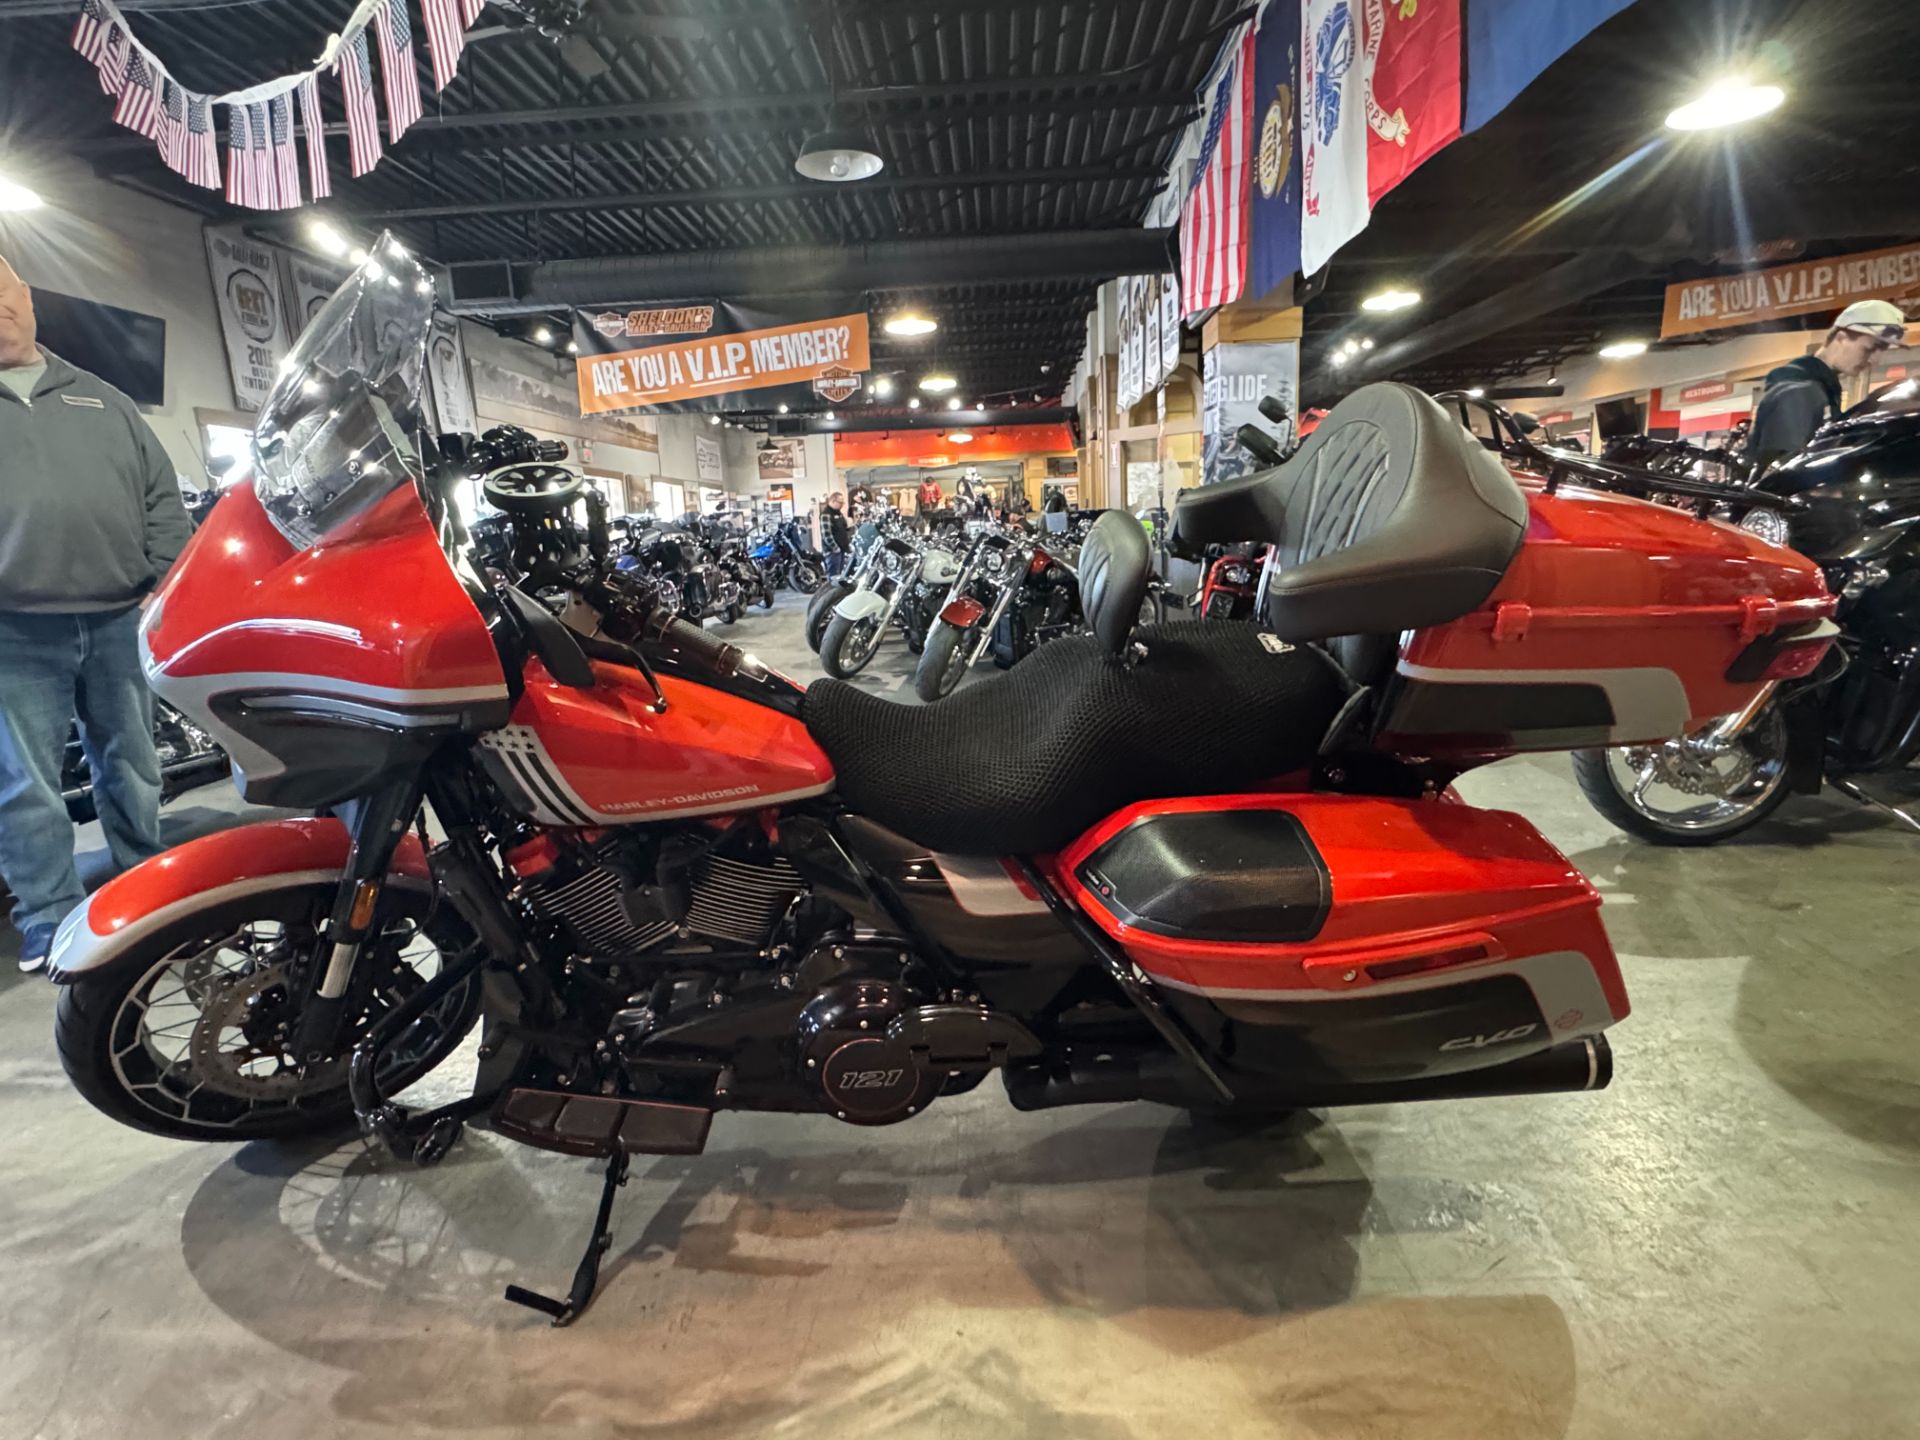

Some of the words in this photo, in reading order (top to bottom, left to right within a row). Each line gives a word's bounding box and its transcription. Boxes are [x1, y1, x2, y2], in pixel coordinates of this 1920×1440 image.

[1679, 284, 1716, 320] ARE
[1718, 278, 1751, 312] YOU
[1756, 275, 1770, 308] A
[1773, 266, 1834, 304] V.I.P.
[628, 307, 712, 326] SHELDON'S
[591, 360, 629, 397] ARE
[628, 353, 666, 390] YOU
[670, 351, 684, 385] A
[684, 343, 750, 382] V.I.P.
[750, 326, 850, 373] MEMBER?
[1219, 374, 1268, 401] GLIDE
[600, 784, 760, 812] HARLEY-DAVIDSON
[1438, 1023, 1538, 1052] CVO
[839, 1068, 904, 1090] 121
